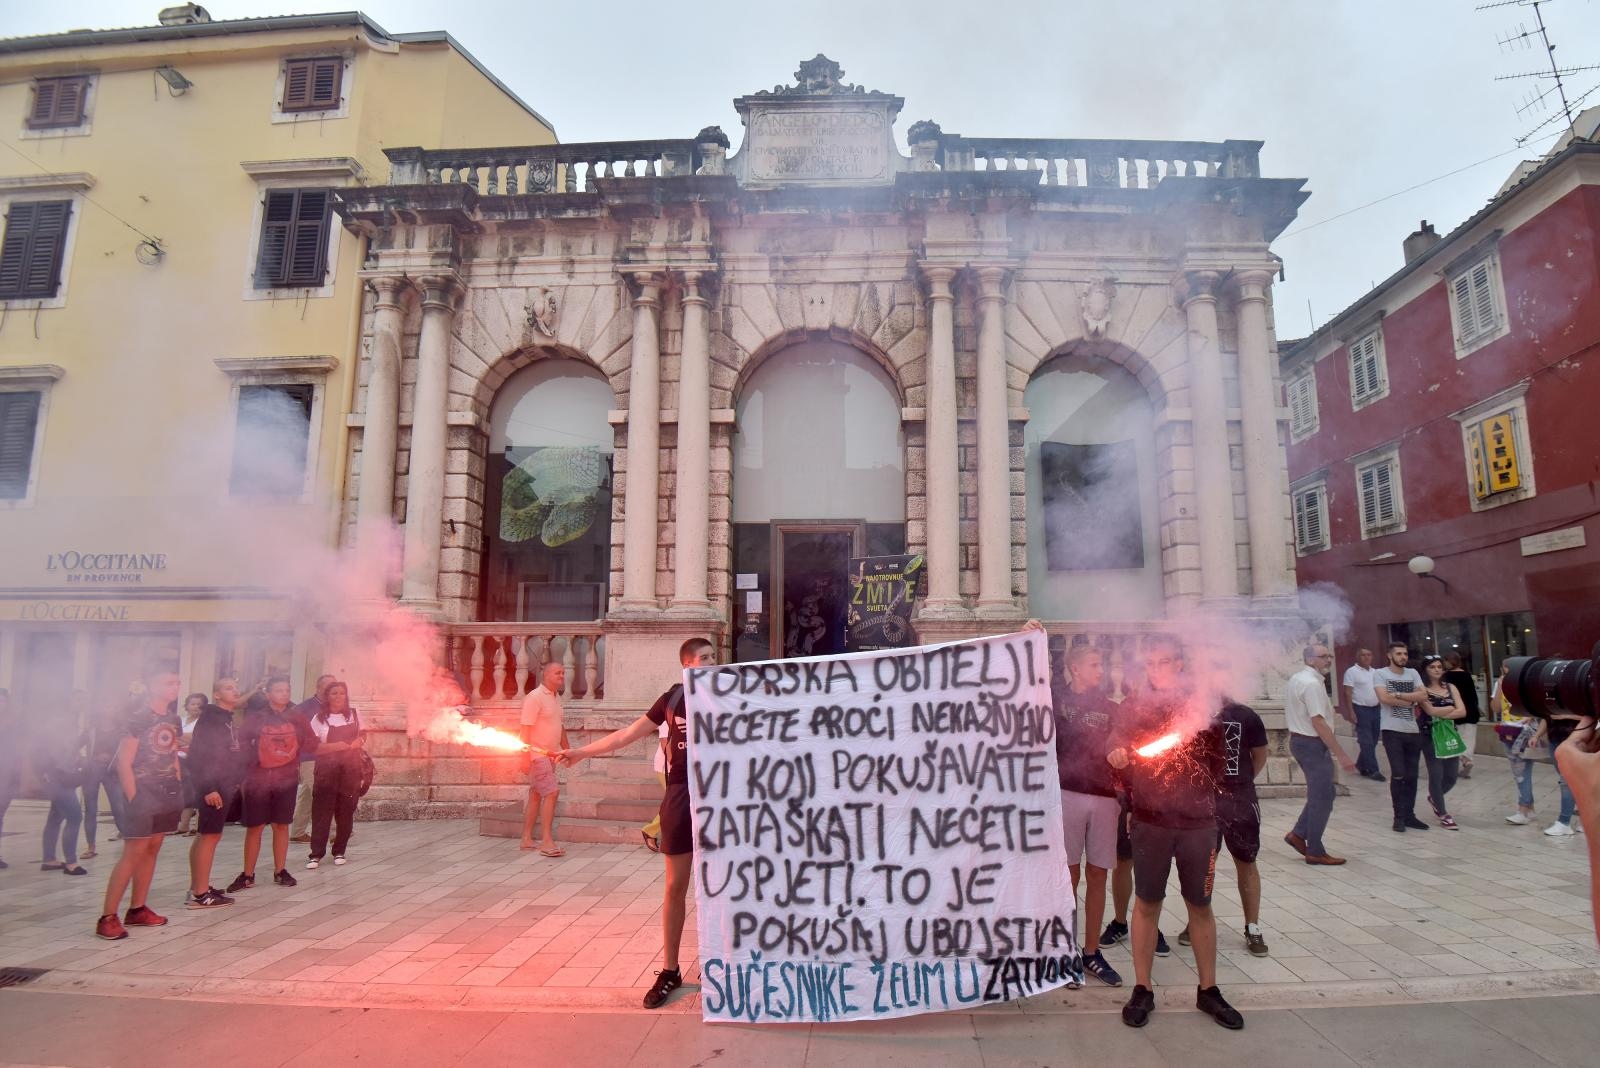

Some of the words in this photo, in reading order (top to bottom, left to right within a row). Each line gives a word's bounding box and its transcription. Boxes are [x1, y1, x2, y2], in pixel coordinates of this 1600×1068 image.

[46, 550, 167, 570] L'OCCITANE
[66, 574, 81, 582] EN
[84, 573, 143, 583] PROVENCE
[19, 601, 130, 620] L'OCCITANE
[694, 701, 800, 745] NEĆETE
[808, 693, 894, 741] PROĆI
[694, 760, 730, 799] VI
[747, 752, 817, 804] KOJI
[832, 739, 1048, 795] POKUŠAVATE
[696, 799, 885, 861] ZATAŠKATI
[909, 793, 1049, 856] NEĆETE
[872, 864, 931, 905] TO
[947, 862, 1003, 911] JE
[733, 904, 888, 964] POKUŠAJ
